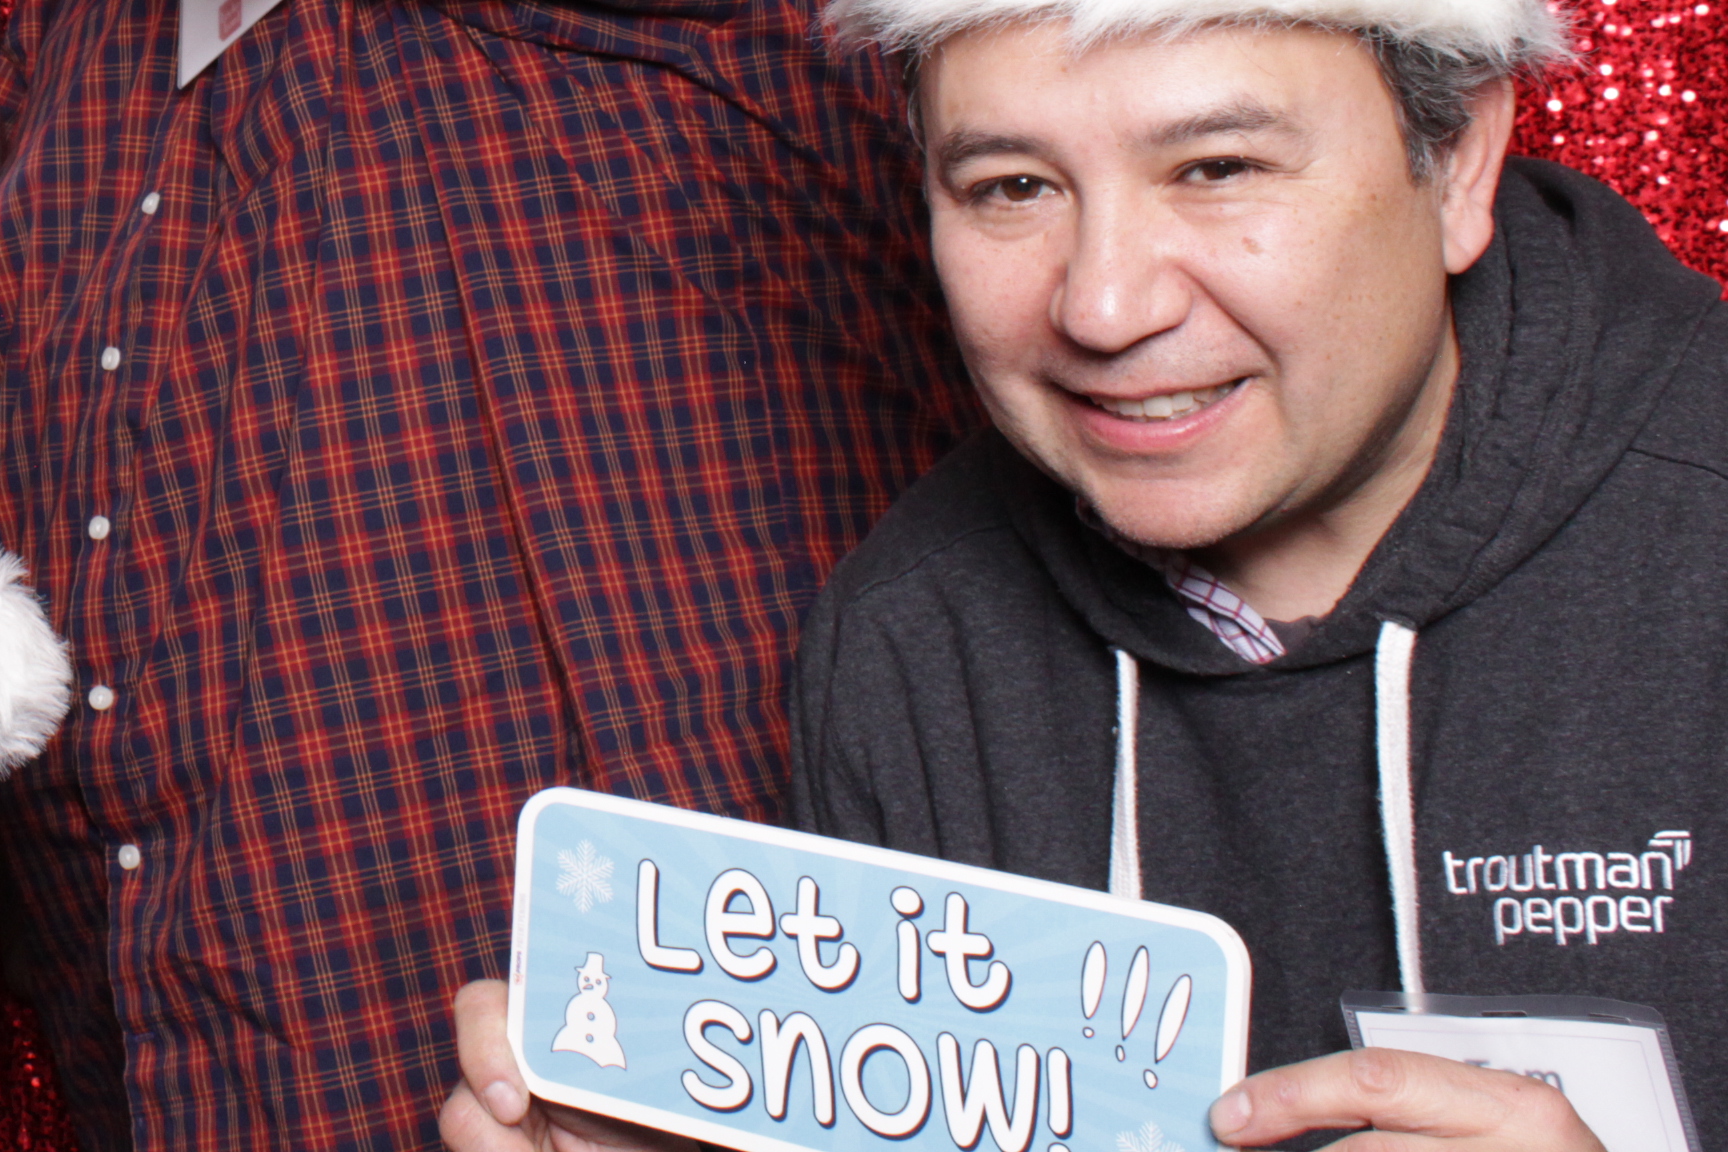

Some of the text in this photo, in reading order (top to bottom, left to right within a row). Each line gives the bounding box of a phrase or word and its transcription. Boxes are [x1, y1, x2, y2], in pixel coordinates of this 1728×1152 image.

[1442, 845, 1674, 895] troutman
[636, 859, 1013, 1011] Let it
[1493, 895, 1674, 946] pepper
